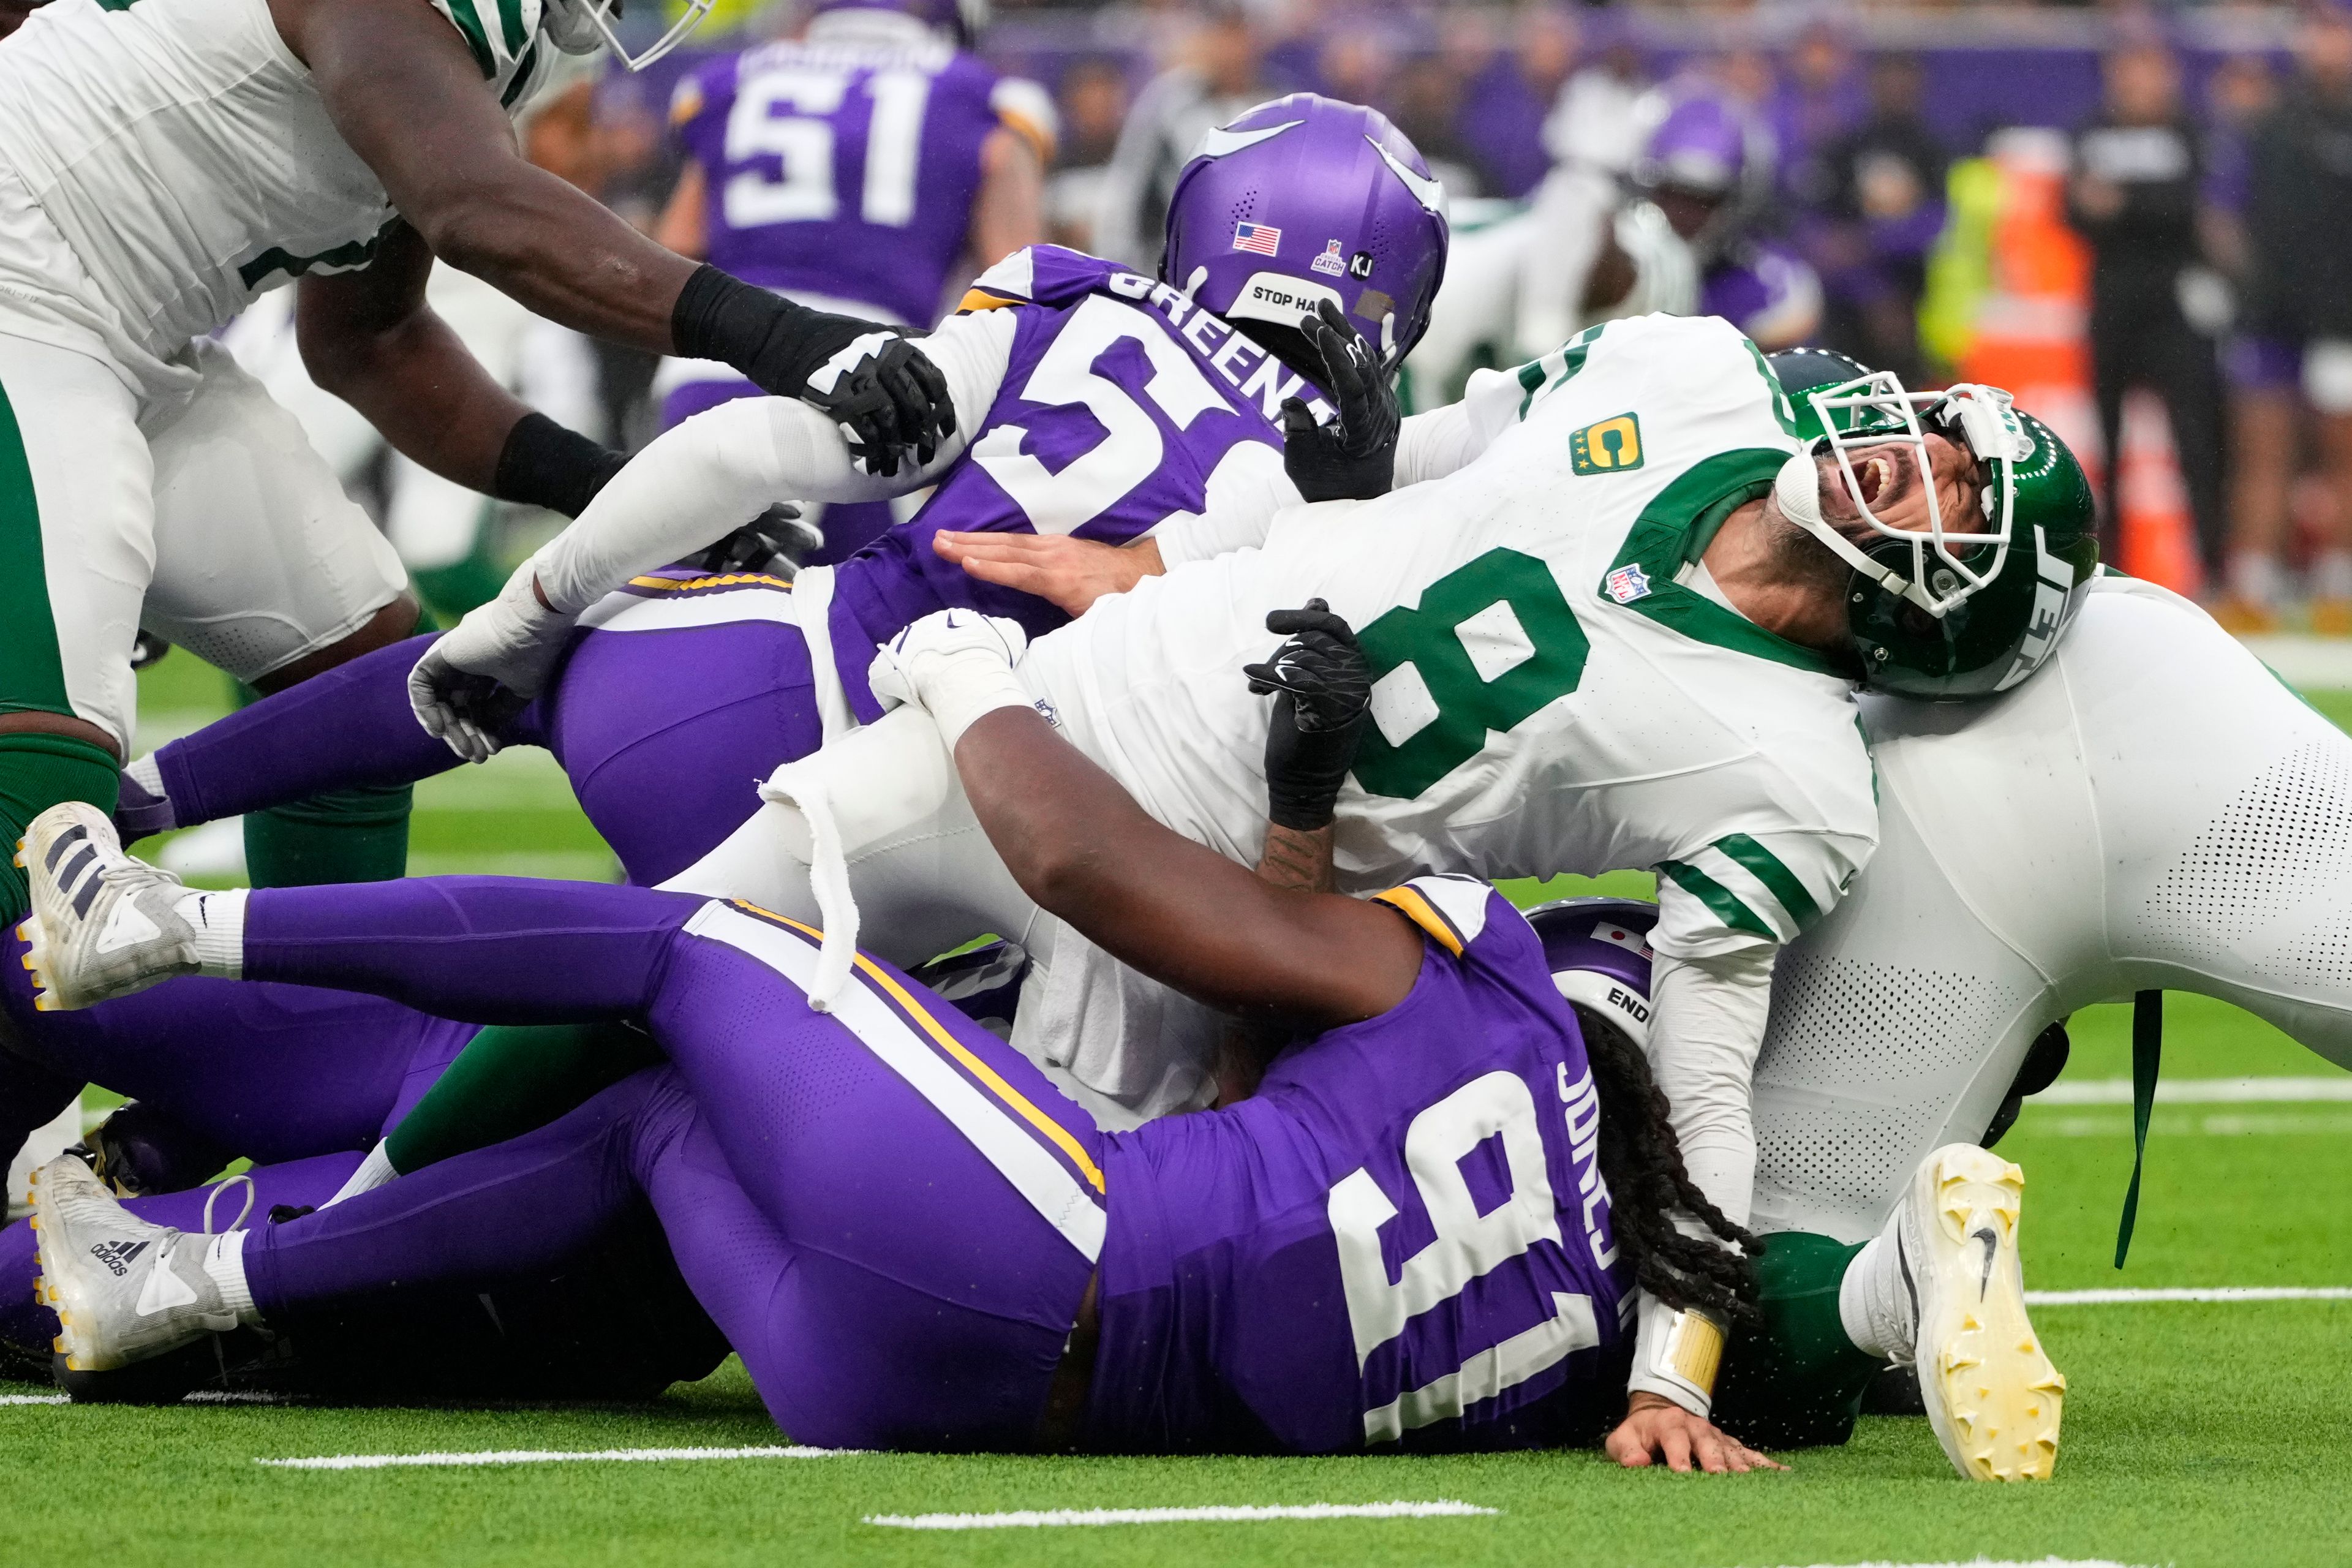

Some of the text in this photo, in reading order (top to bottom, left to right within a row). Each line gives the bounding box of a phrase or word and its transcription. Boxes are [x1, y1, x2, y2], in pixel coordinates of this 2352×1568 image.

[724, 72, 929, 228] 51
[1314, 258, 1344, 272] CATCH
[1350, 254, 1372, 277] KJ
[1253, 286, 1319, 314] STOP HA
[971, 293, 1284, 535] 5
[1587, 417, 1638, 467] C
[1993, 524, 2075, 692] JETS
[1349, 546, 1591, 800] 8
[1607, 987, 1649, 1023] END
[1557, 1061, 1619, 1271] JONES
[90, 1243, 127, 1276] adidas
